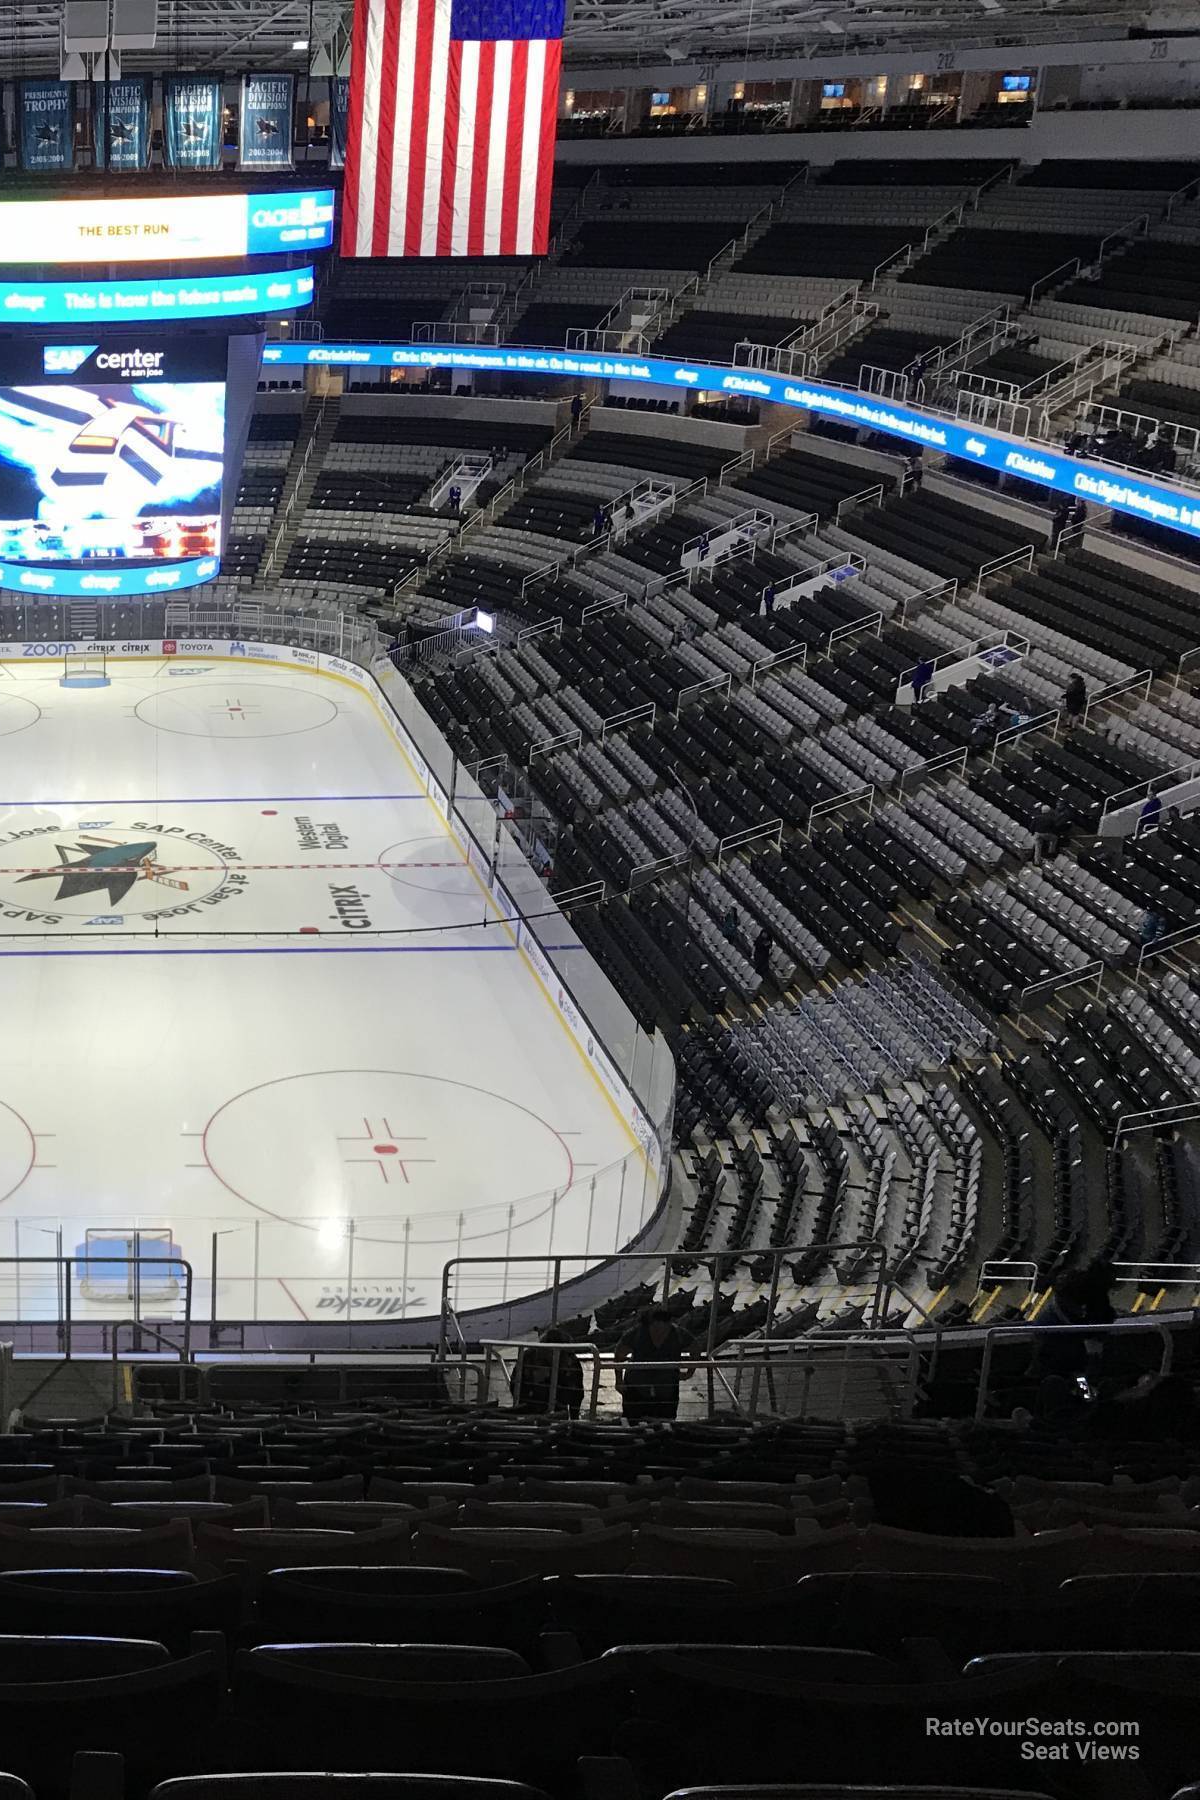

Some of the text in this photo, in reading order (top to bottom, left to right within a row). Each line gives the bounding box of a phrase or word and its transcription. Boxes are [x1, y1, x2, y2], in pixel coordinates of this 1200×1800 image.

[937, 53, 955, 69] 212
[174, 85, 213, 95] PACIFIC
[249, 82, 288, 94] PACIFIC
[174, 95, 213, 105] DIVISION
[248, 93, 287, 103] DIVISION
[25, 100, 68, 112] TROPHY
[174, 104, 212, 113] CHAMPIONS
[248, 102, 287, 110] CHAMPIONS
[79, 224, 169, 236] THE BEST RUN
[64, 292, 97, 309] This
[97, 291, 113, 308] is
[114, 292, 149, 308] how
[150, 290, 176, 307] the
[177, 288, 220, 305] future
[45, 348, 164, 370] SAP center
[392, 351, 420, 363] Citrix
[420, 351, 451, 365] Digital
[517, 356, 535, 368] the
[550, 357, 563, 370] On
[563, 358, 579, 371] the
[614, 363, 630, 375] the
[121, 368, 164, 378] at san jose
[1074, 472, 1098, 494] Citrix
[1097, 479, 1128, 503] Digital
[1126, 487, 1180, 521] Workspace.
[1179, 506, 1192, 525] In
[22, 643, 76, 656] zoom
[180, 643, 214, 651] TOYOTA
[8, 825, 61, 840] Jose
[79, 822, 108, 830] SAP
[294, 816, 322, 851] Western
[315, 823, 349, 850] Digital
[130, 822, 243, 861] SAP Center
[142, 873, 249, 920] at San Jose
[2, 909, 63, 925] SAP
[91, 916, 123, 925] SAP
[315, 1294, 428, 1316] Alaska
